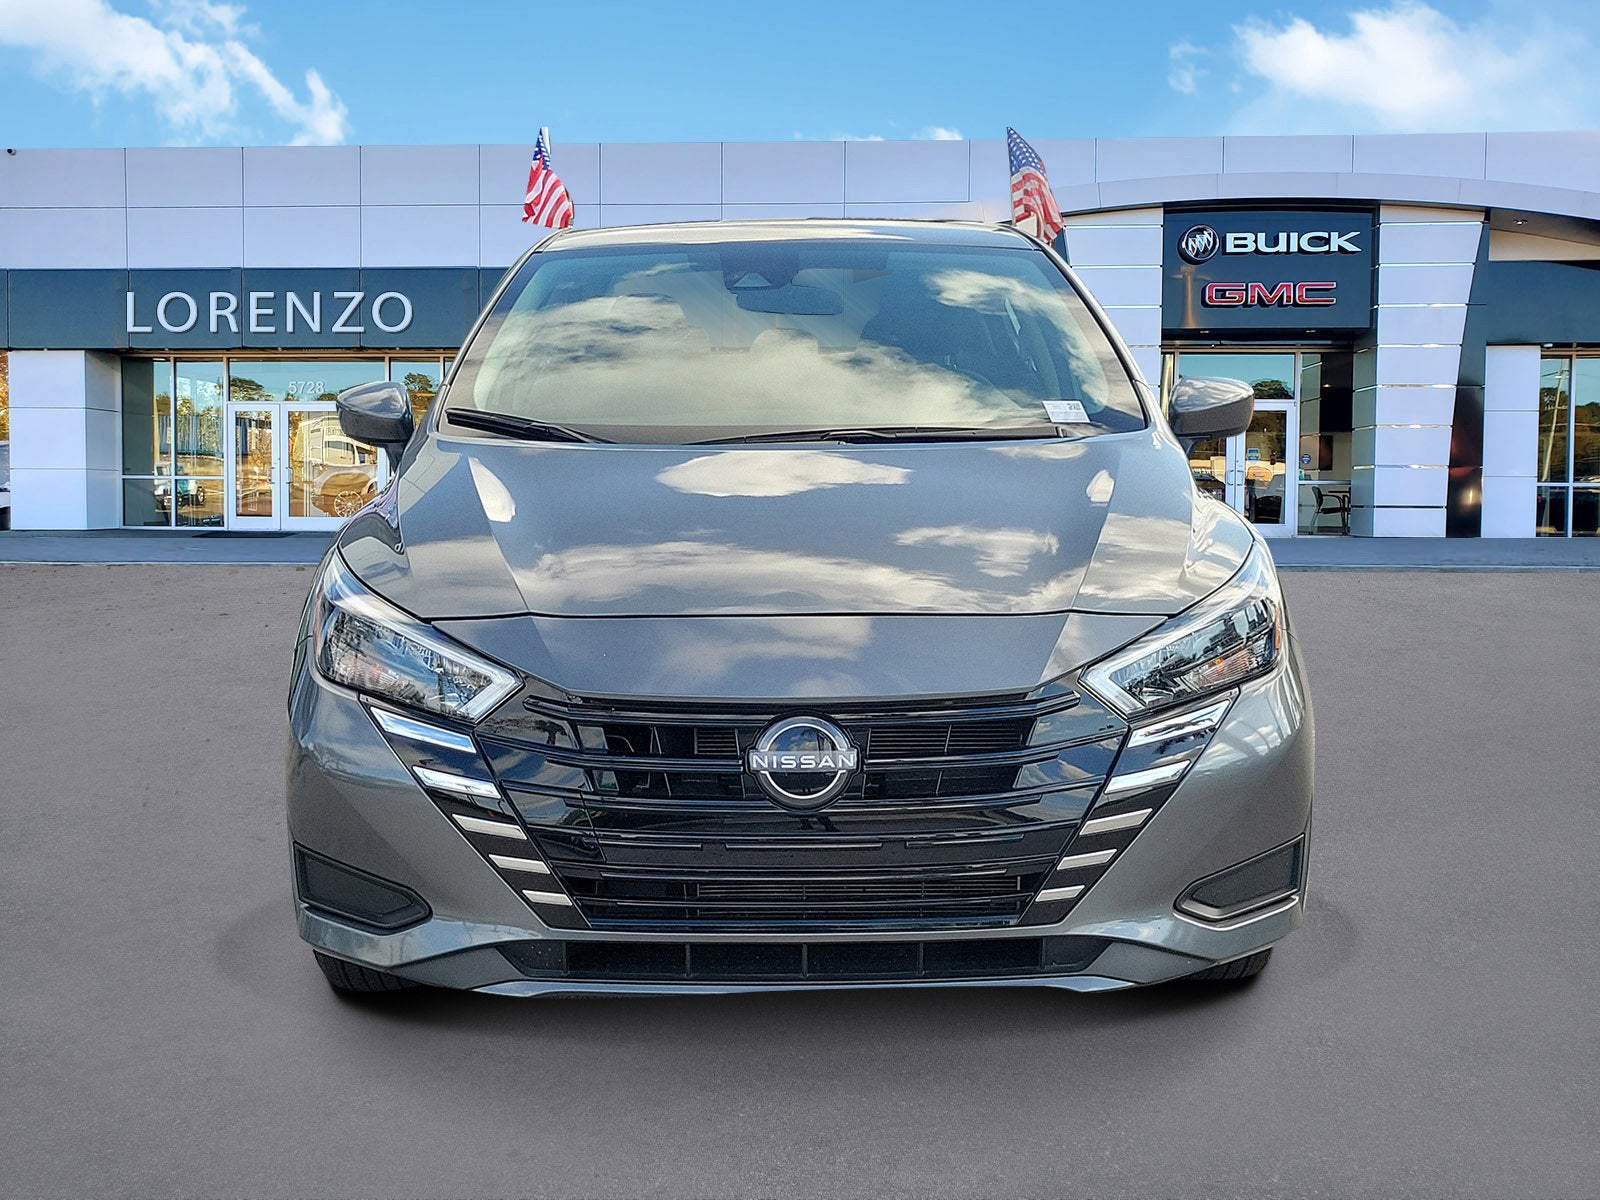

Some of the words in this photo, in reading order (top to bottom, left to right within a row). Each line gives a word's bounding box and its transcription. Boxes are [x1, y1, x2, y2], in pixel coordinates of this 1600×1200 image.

[1225, 231, 1362, 253] BUICK
[1205, 282, 1337, 305] GMC
[126, 291, 413, 333] LORENZO
[288, 380, 325, 394] 5728
[751, 754, 855, 769] NISSAN
